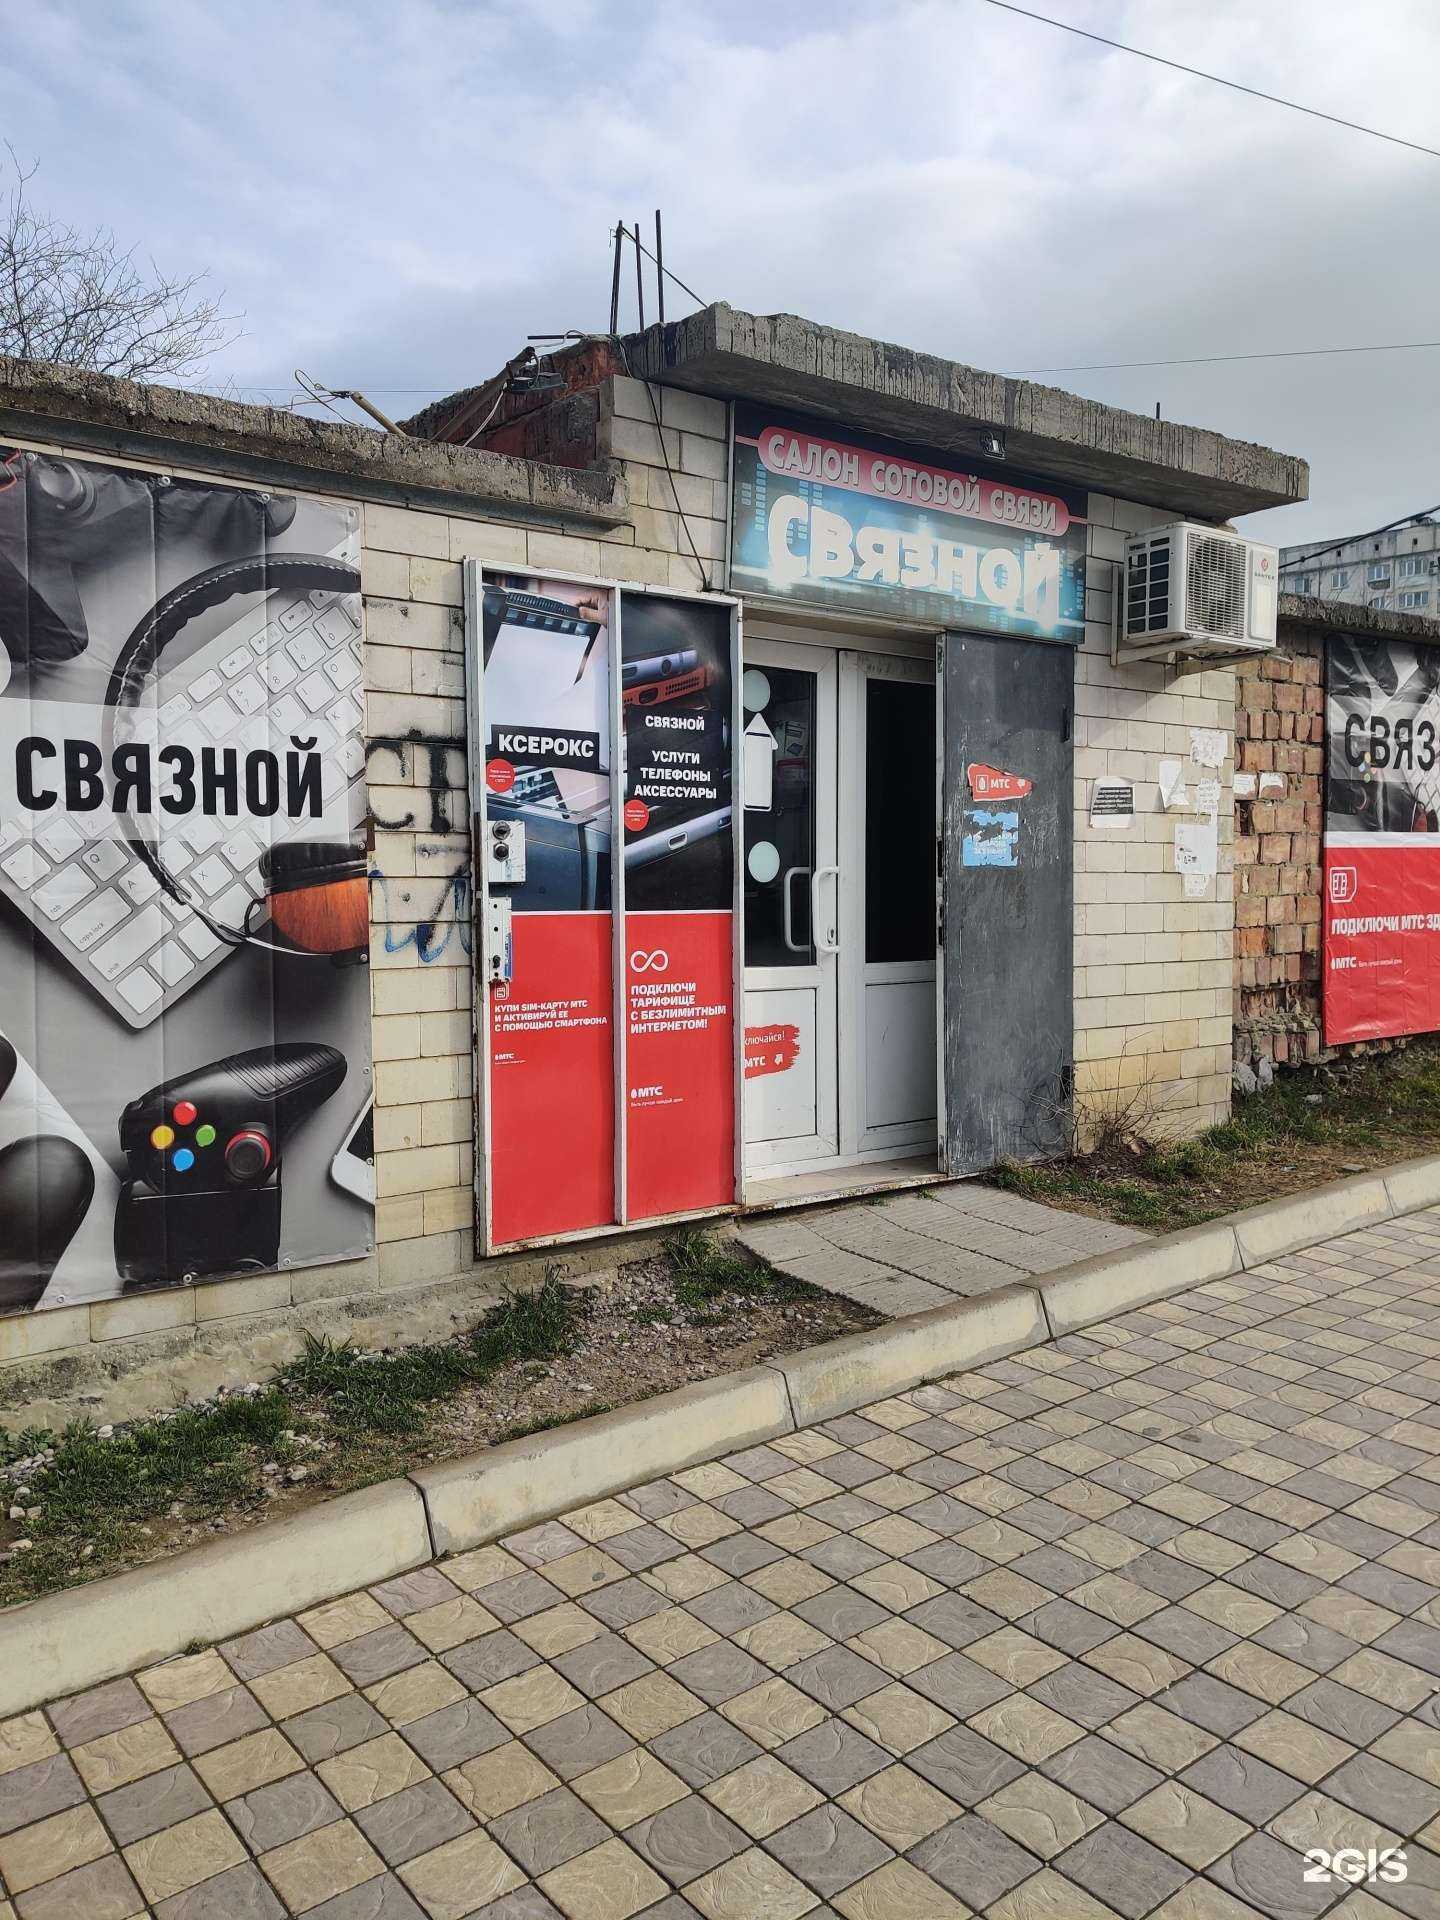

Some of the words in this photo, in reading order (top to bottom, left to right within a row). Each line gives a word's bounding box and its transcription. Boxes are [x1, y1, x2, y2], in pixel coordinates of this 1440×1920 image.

[768, 434, 860, 486] САЛОН
[870, 460, 981, 514] СОТОВОЙ
[990, 489, 1057, 532] СВЯЗИ
[645, 715, 705, 731] СВЯЗНОЙ
[498, 733, 595, 758] КСЕРОКС
[651, 750, 700, 765] УСЛУГИ
[15, 735, 324, 818] СВЯЗНОЙ
[640, 767, 711, 782] ТЕЛЕФОНЫ
[991, 778, 1010, 789] МТС
[634, 784, 717, 799] АКСЕССУАРЫ
[1331, 915, 1399, 936] ПОДКЛЮЧИ
[1401, 914, 1425, 930] МТС
[1336, 957, 1357, 969] МТС
[631, 982, 697, 996] ПОДКЛЮЧИ
[495, 1004, 519, 1013] КУПИ
[521, 1001, 570, 1011] SIM-КАРТУ
[570, 1000, 589, 1009] МТС
[631, 995, 696, 1008] ТАРИФИЩЕ
[495, 1014, 502, 1022] И
[503, 1010, 557, 1022] АКТИВИРУЙ
[558, 1010, 569, 1018] ЕЕ
[631, 1011, 639, 1020] С
[640, 1005, 727, 1020] БЕЗЛИМИТНЫМ
[495, 1023, 501, 1032] С
[503, 1020, 553, 1031] ПОМОЩЬЮ
[554, 1017, 608, 1028] СМАРТФОНА
[631, 1019, 708, 1034] ИНТЕРНЕТОМ!
[499, 1052, 515, 1060] МТС
[745, 1055, 766, 1068] МТС
[638, 1086, 663, 1098] МТС
